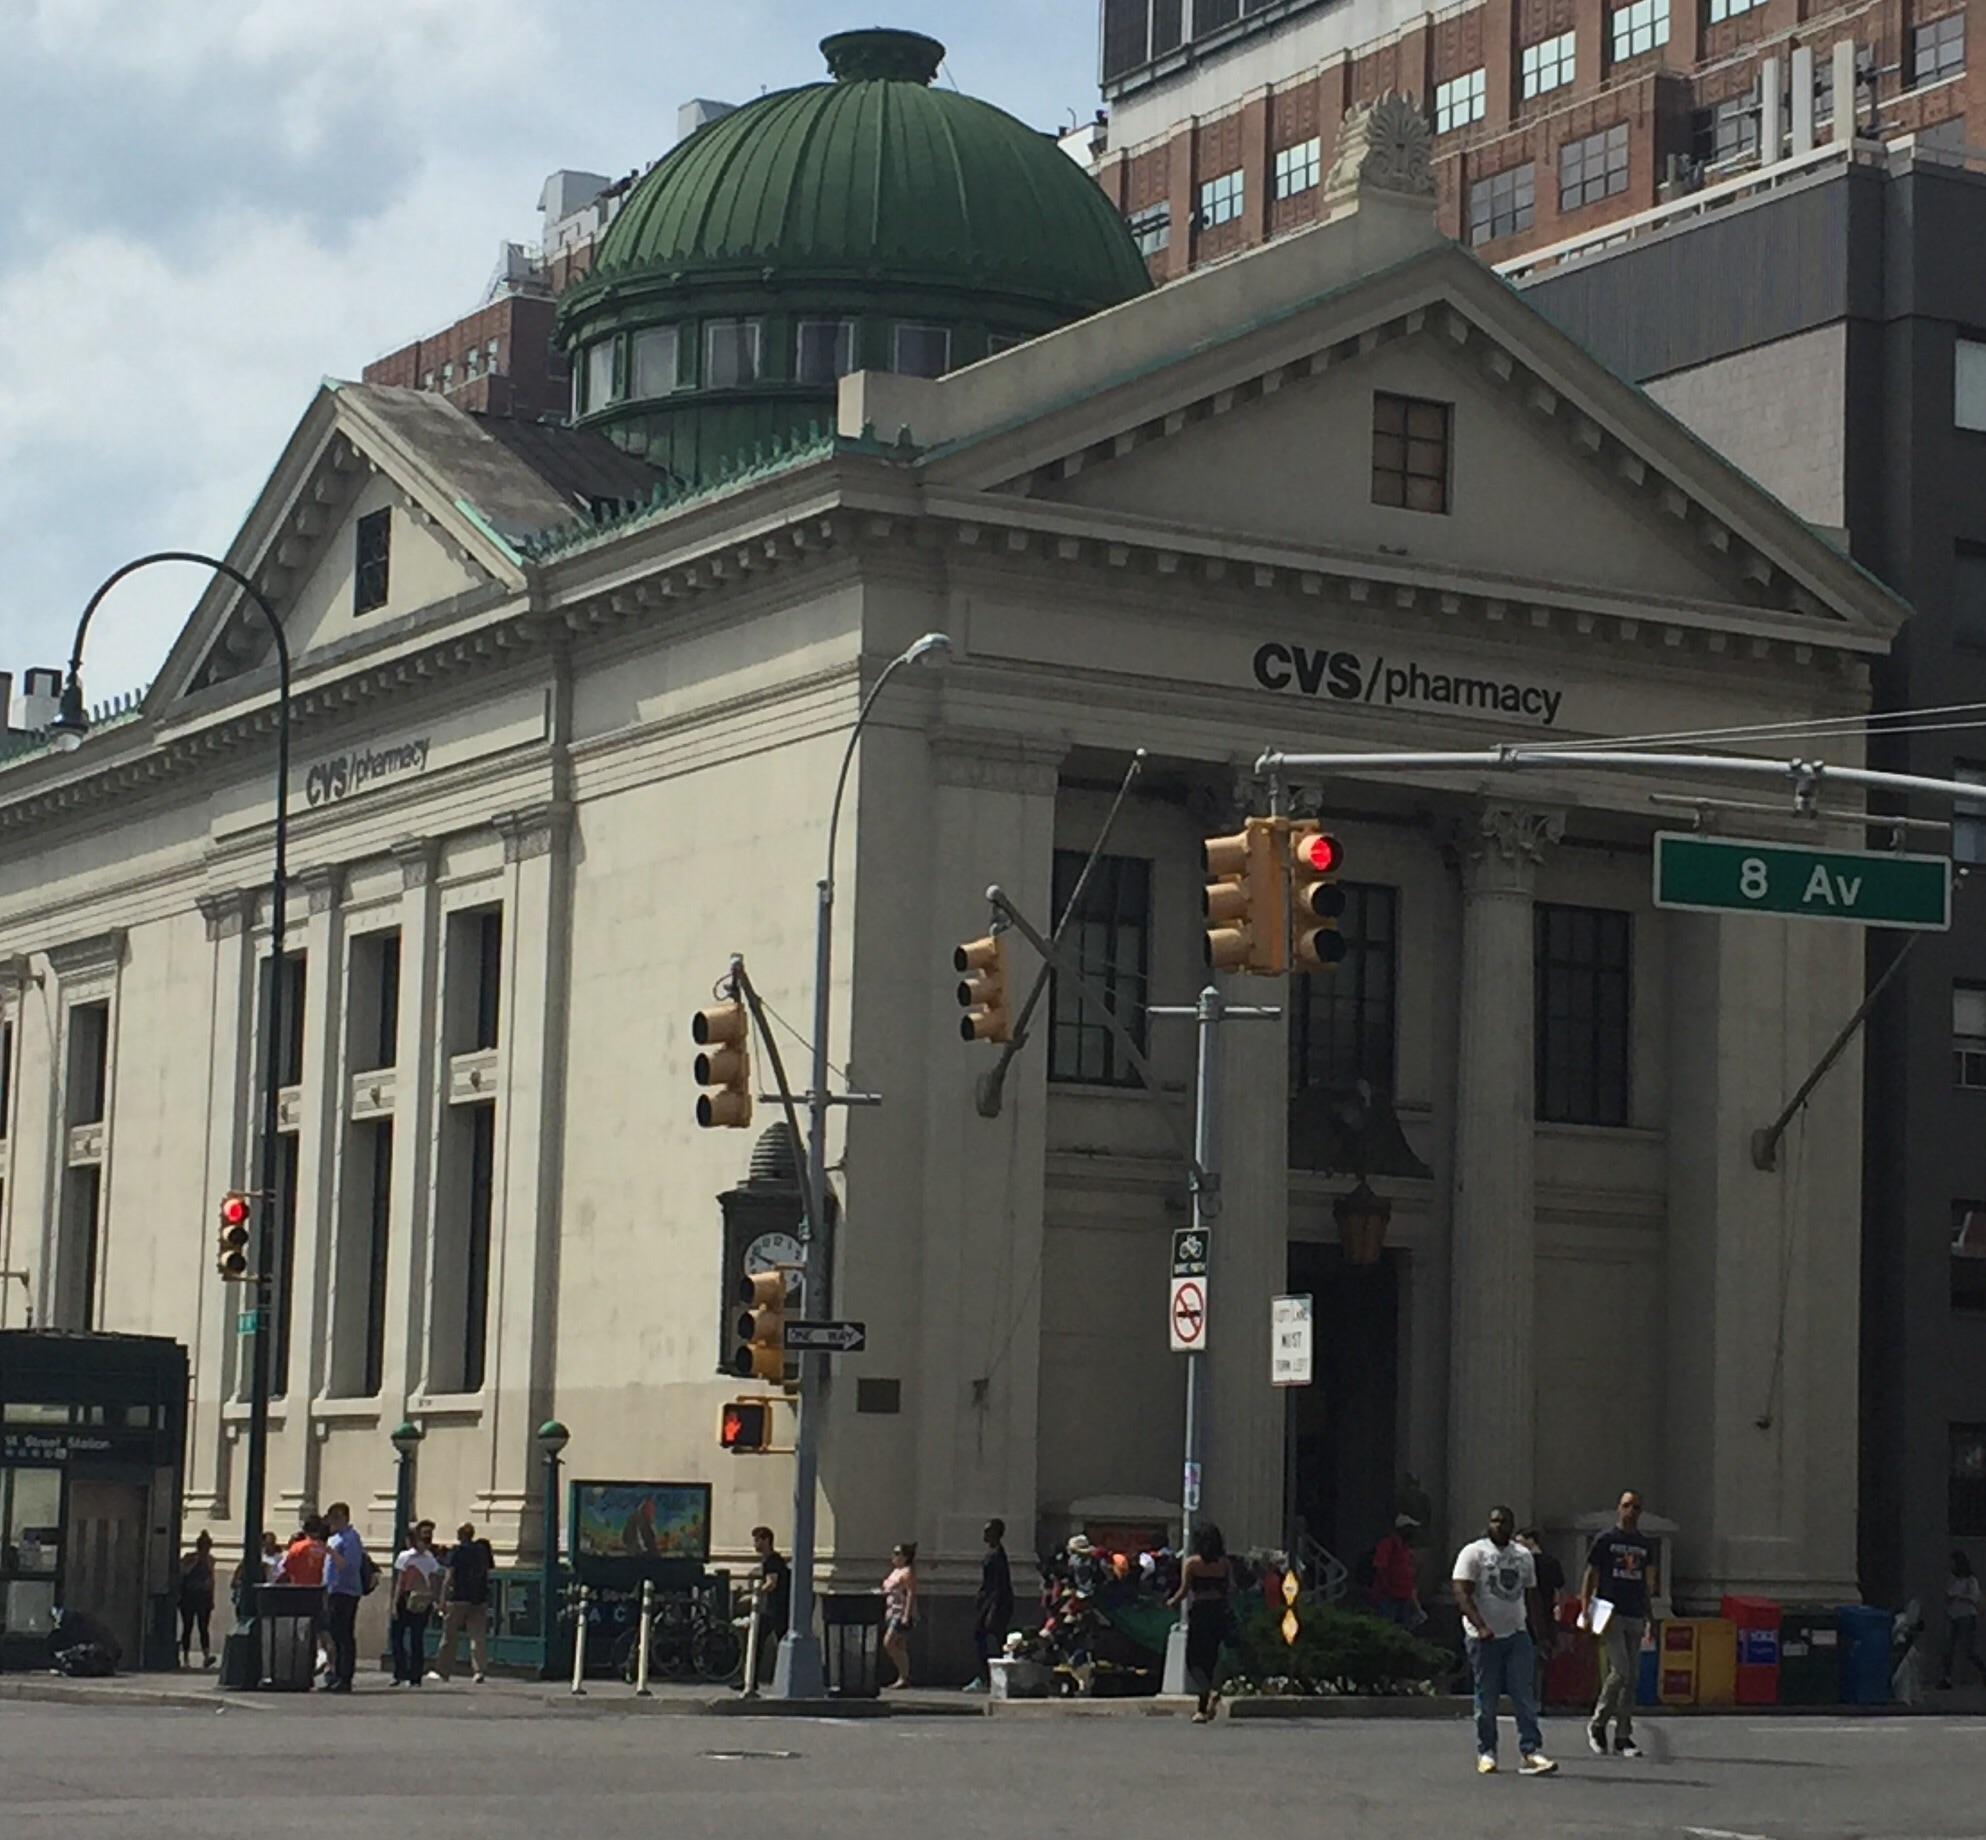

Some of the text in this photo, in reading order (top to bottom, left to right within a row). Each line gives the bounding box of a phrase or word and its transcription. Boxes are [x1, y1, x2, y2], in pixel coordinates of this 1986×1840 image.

[1252, 641, 1562, 725] CVS/pharmacy
[307, 736, 431, 807] CVS/pharmacy
[1740, 857, 1863, 907] 8 Av
[790, 1328, 856, 1344] ONE WAY
[1281, 1331, 1303, 1349] MUST
[24, 1434, 61, 1448] Street
[68, 1436, 112, 1450] Station
[589, 1605, 627, 1622] A C
